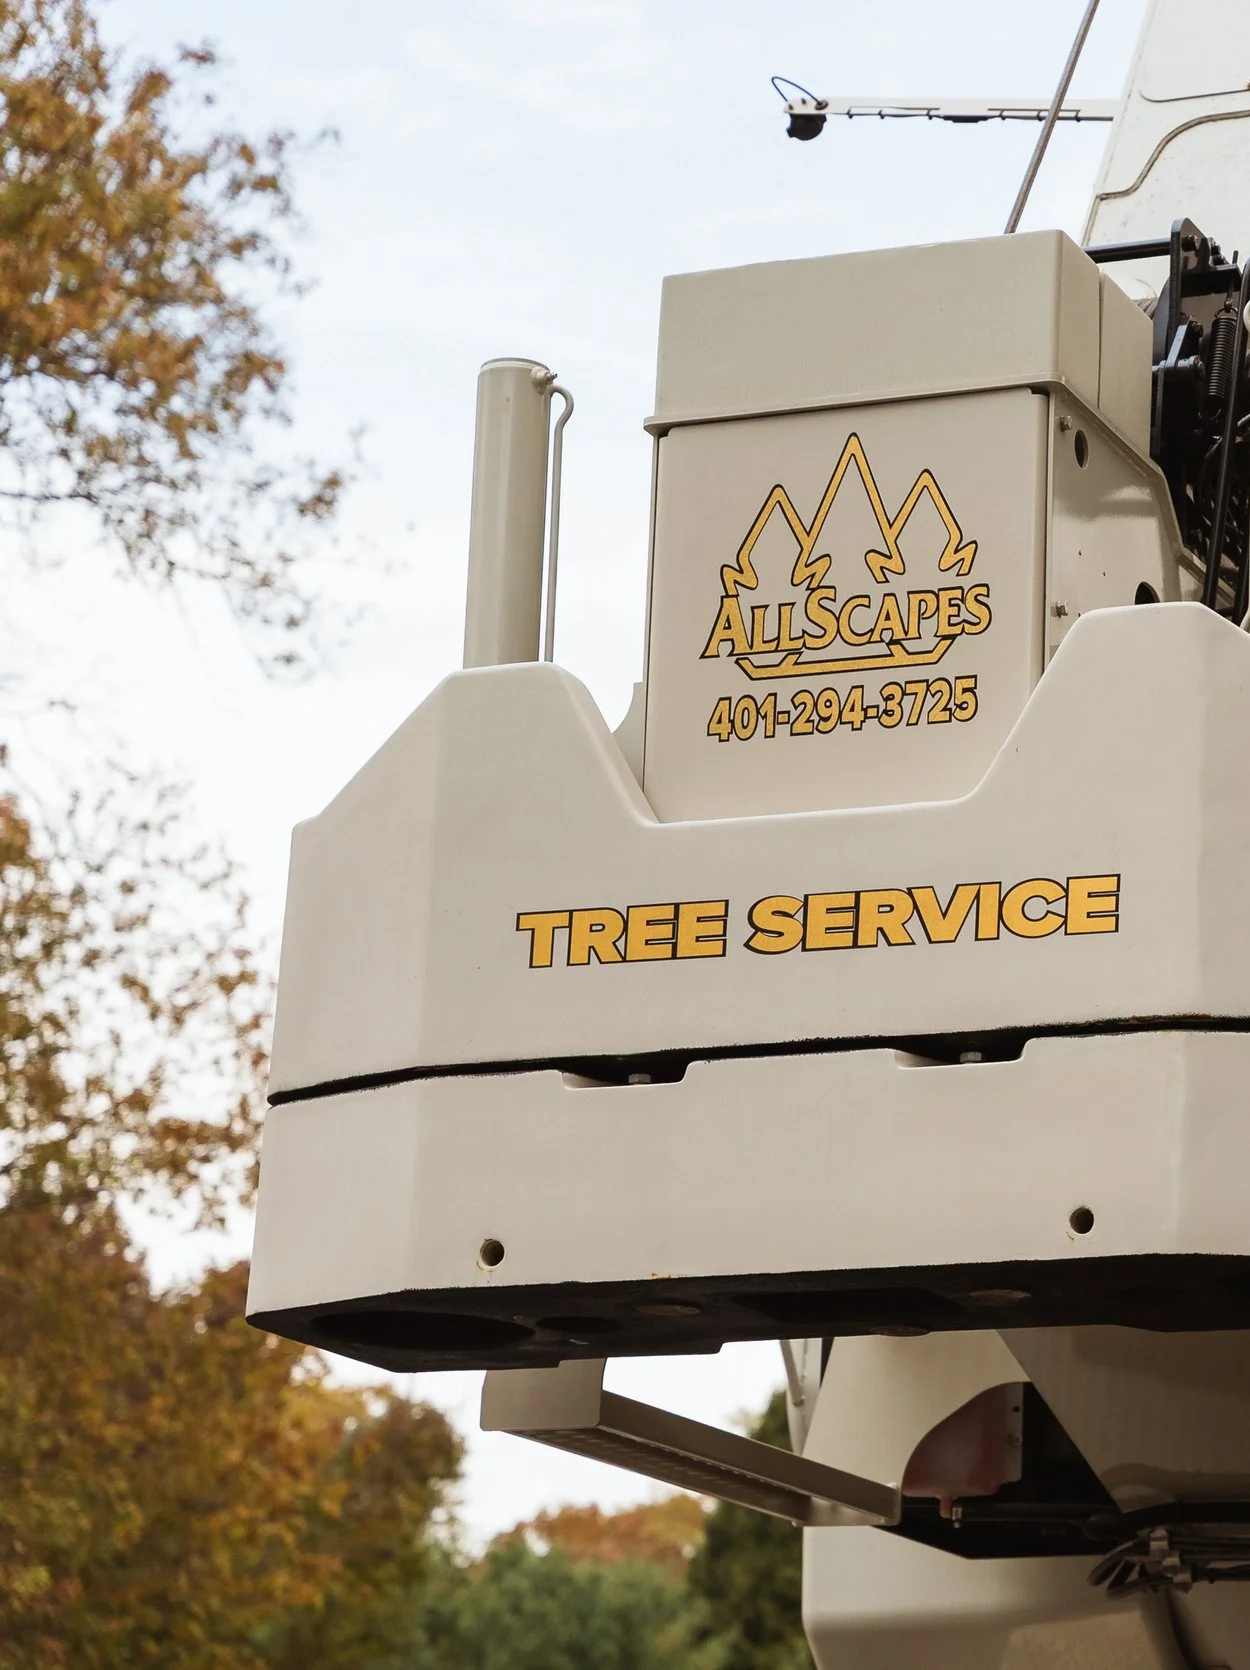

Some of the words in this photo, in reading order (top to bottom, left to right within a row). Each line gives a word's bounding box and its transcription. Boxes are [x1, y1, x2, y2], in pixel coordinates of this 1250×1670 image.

[707, 674, 978, 743] 401-294-3725
[515, 899, 729, 969] TREE
[743, 873, 1121, 955] SERVICE
